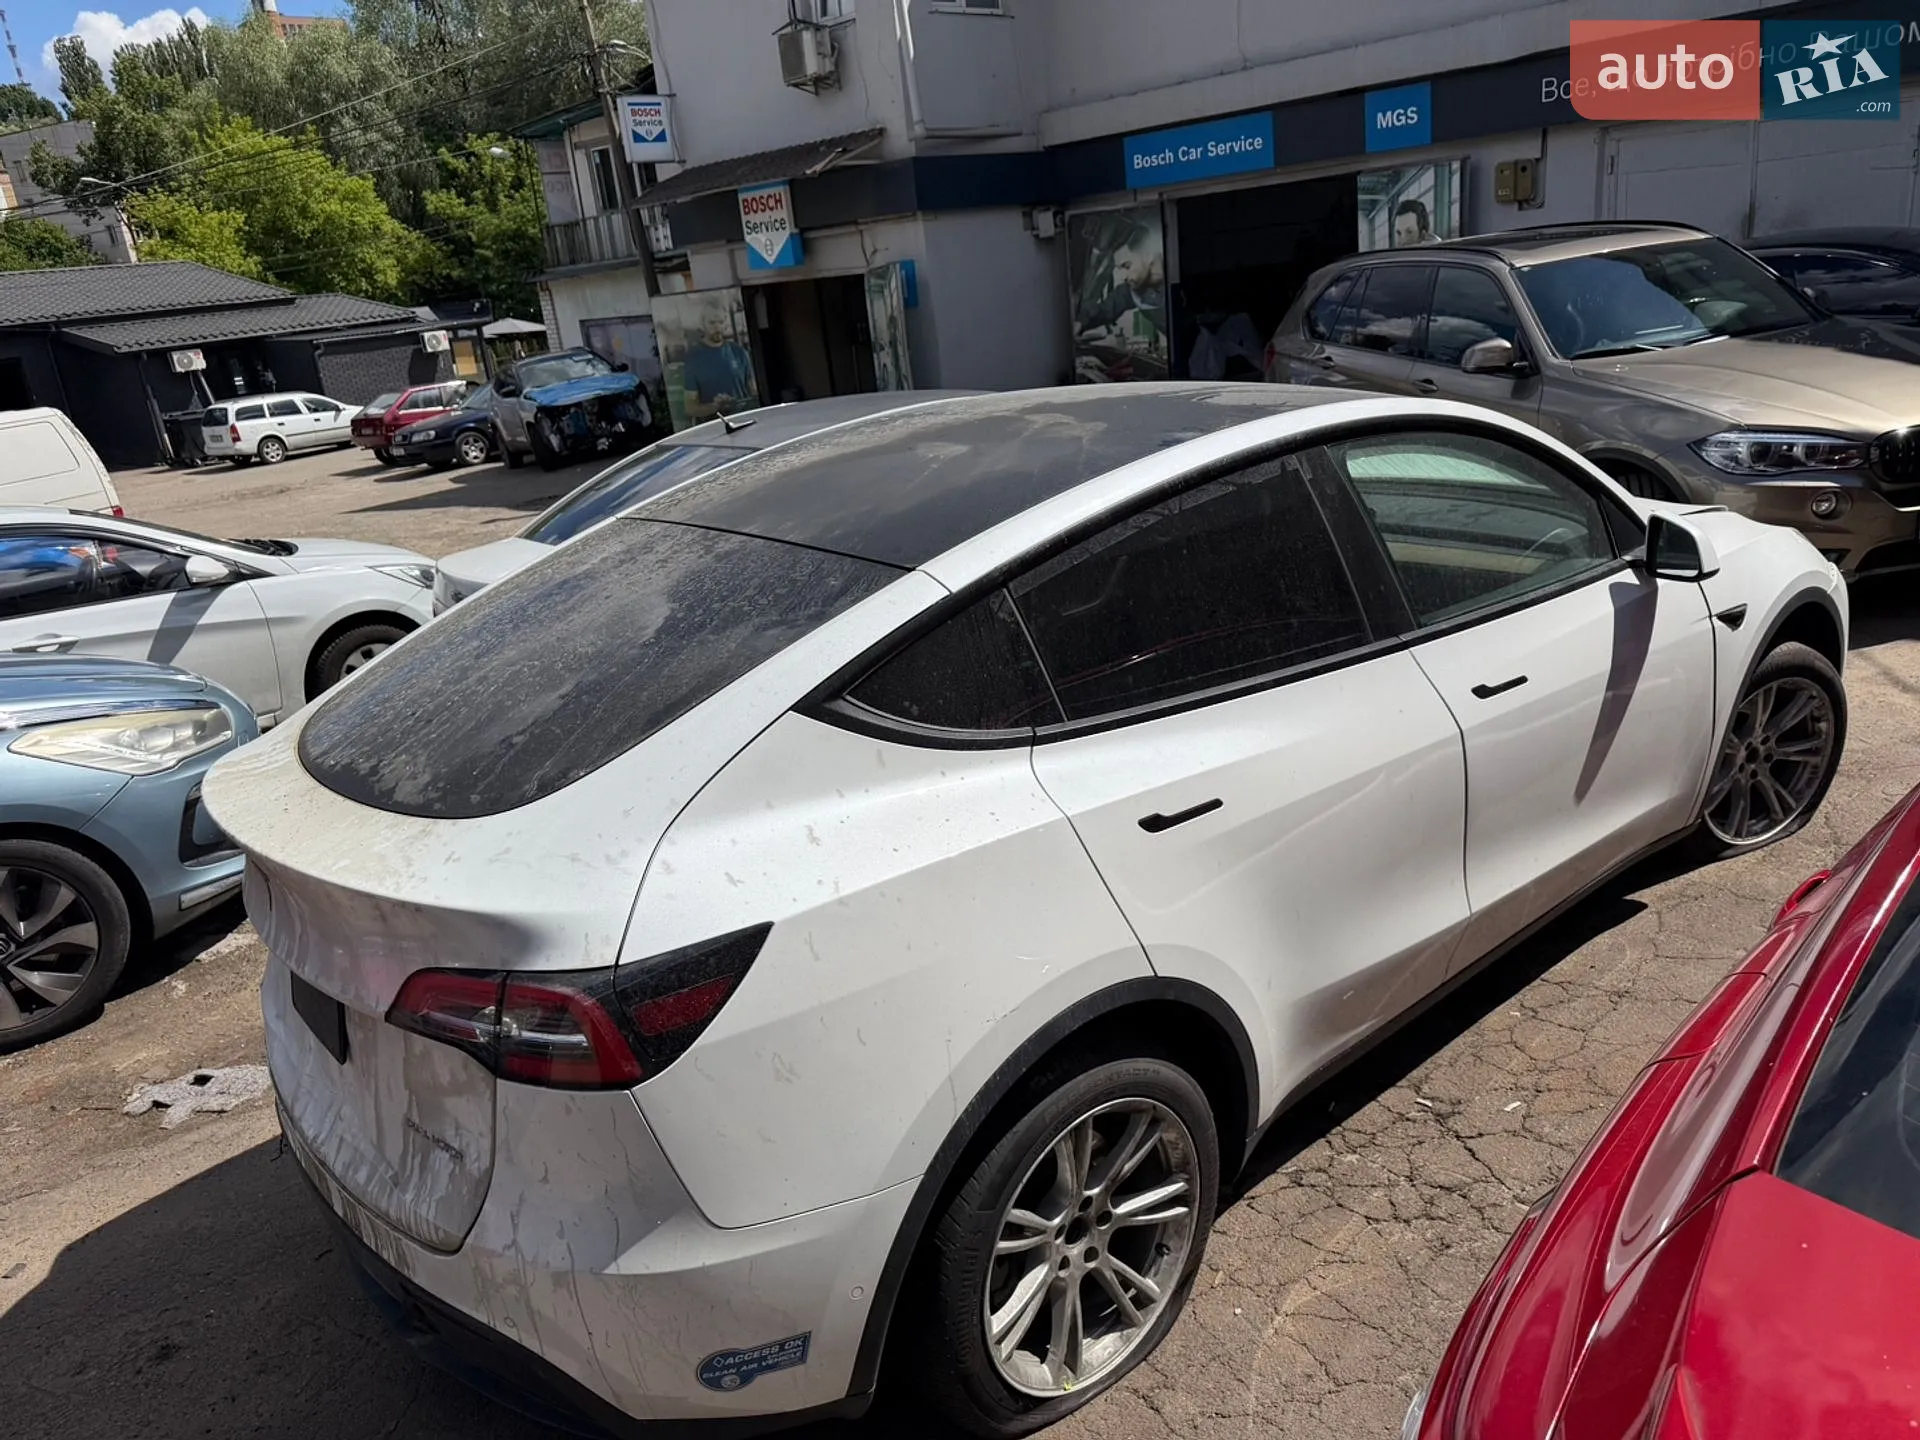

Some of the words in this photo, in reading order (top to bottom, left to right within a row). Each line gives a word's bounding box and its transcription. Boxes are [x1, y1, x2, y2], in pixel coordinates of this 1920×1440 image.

[631, 108, 661, 117] BOSCH
[632, 119, 663, 127] Service
[1376, 106, 1419, 130] MGS
[1133, 149, 1174, 170] Bosch
[1178, 145, 1203, 162] Car
[1207, 135, 1264, 158] Service
[742, 192, 784, 216] BOSCH
[745, 215, 788, 236] Service
[724, 1345, 780, 1366] ACCESS
[784, 1337, 804, 1350] OK
